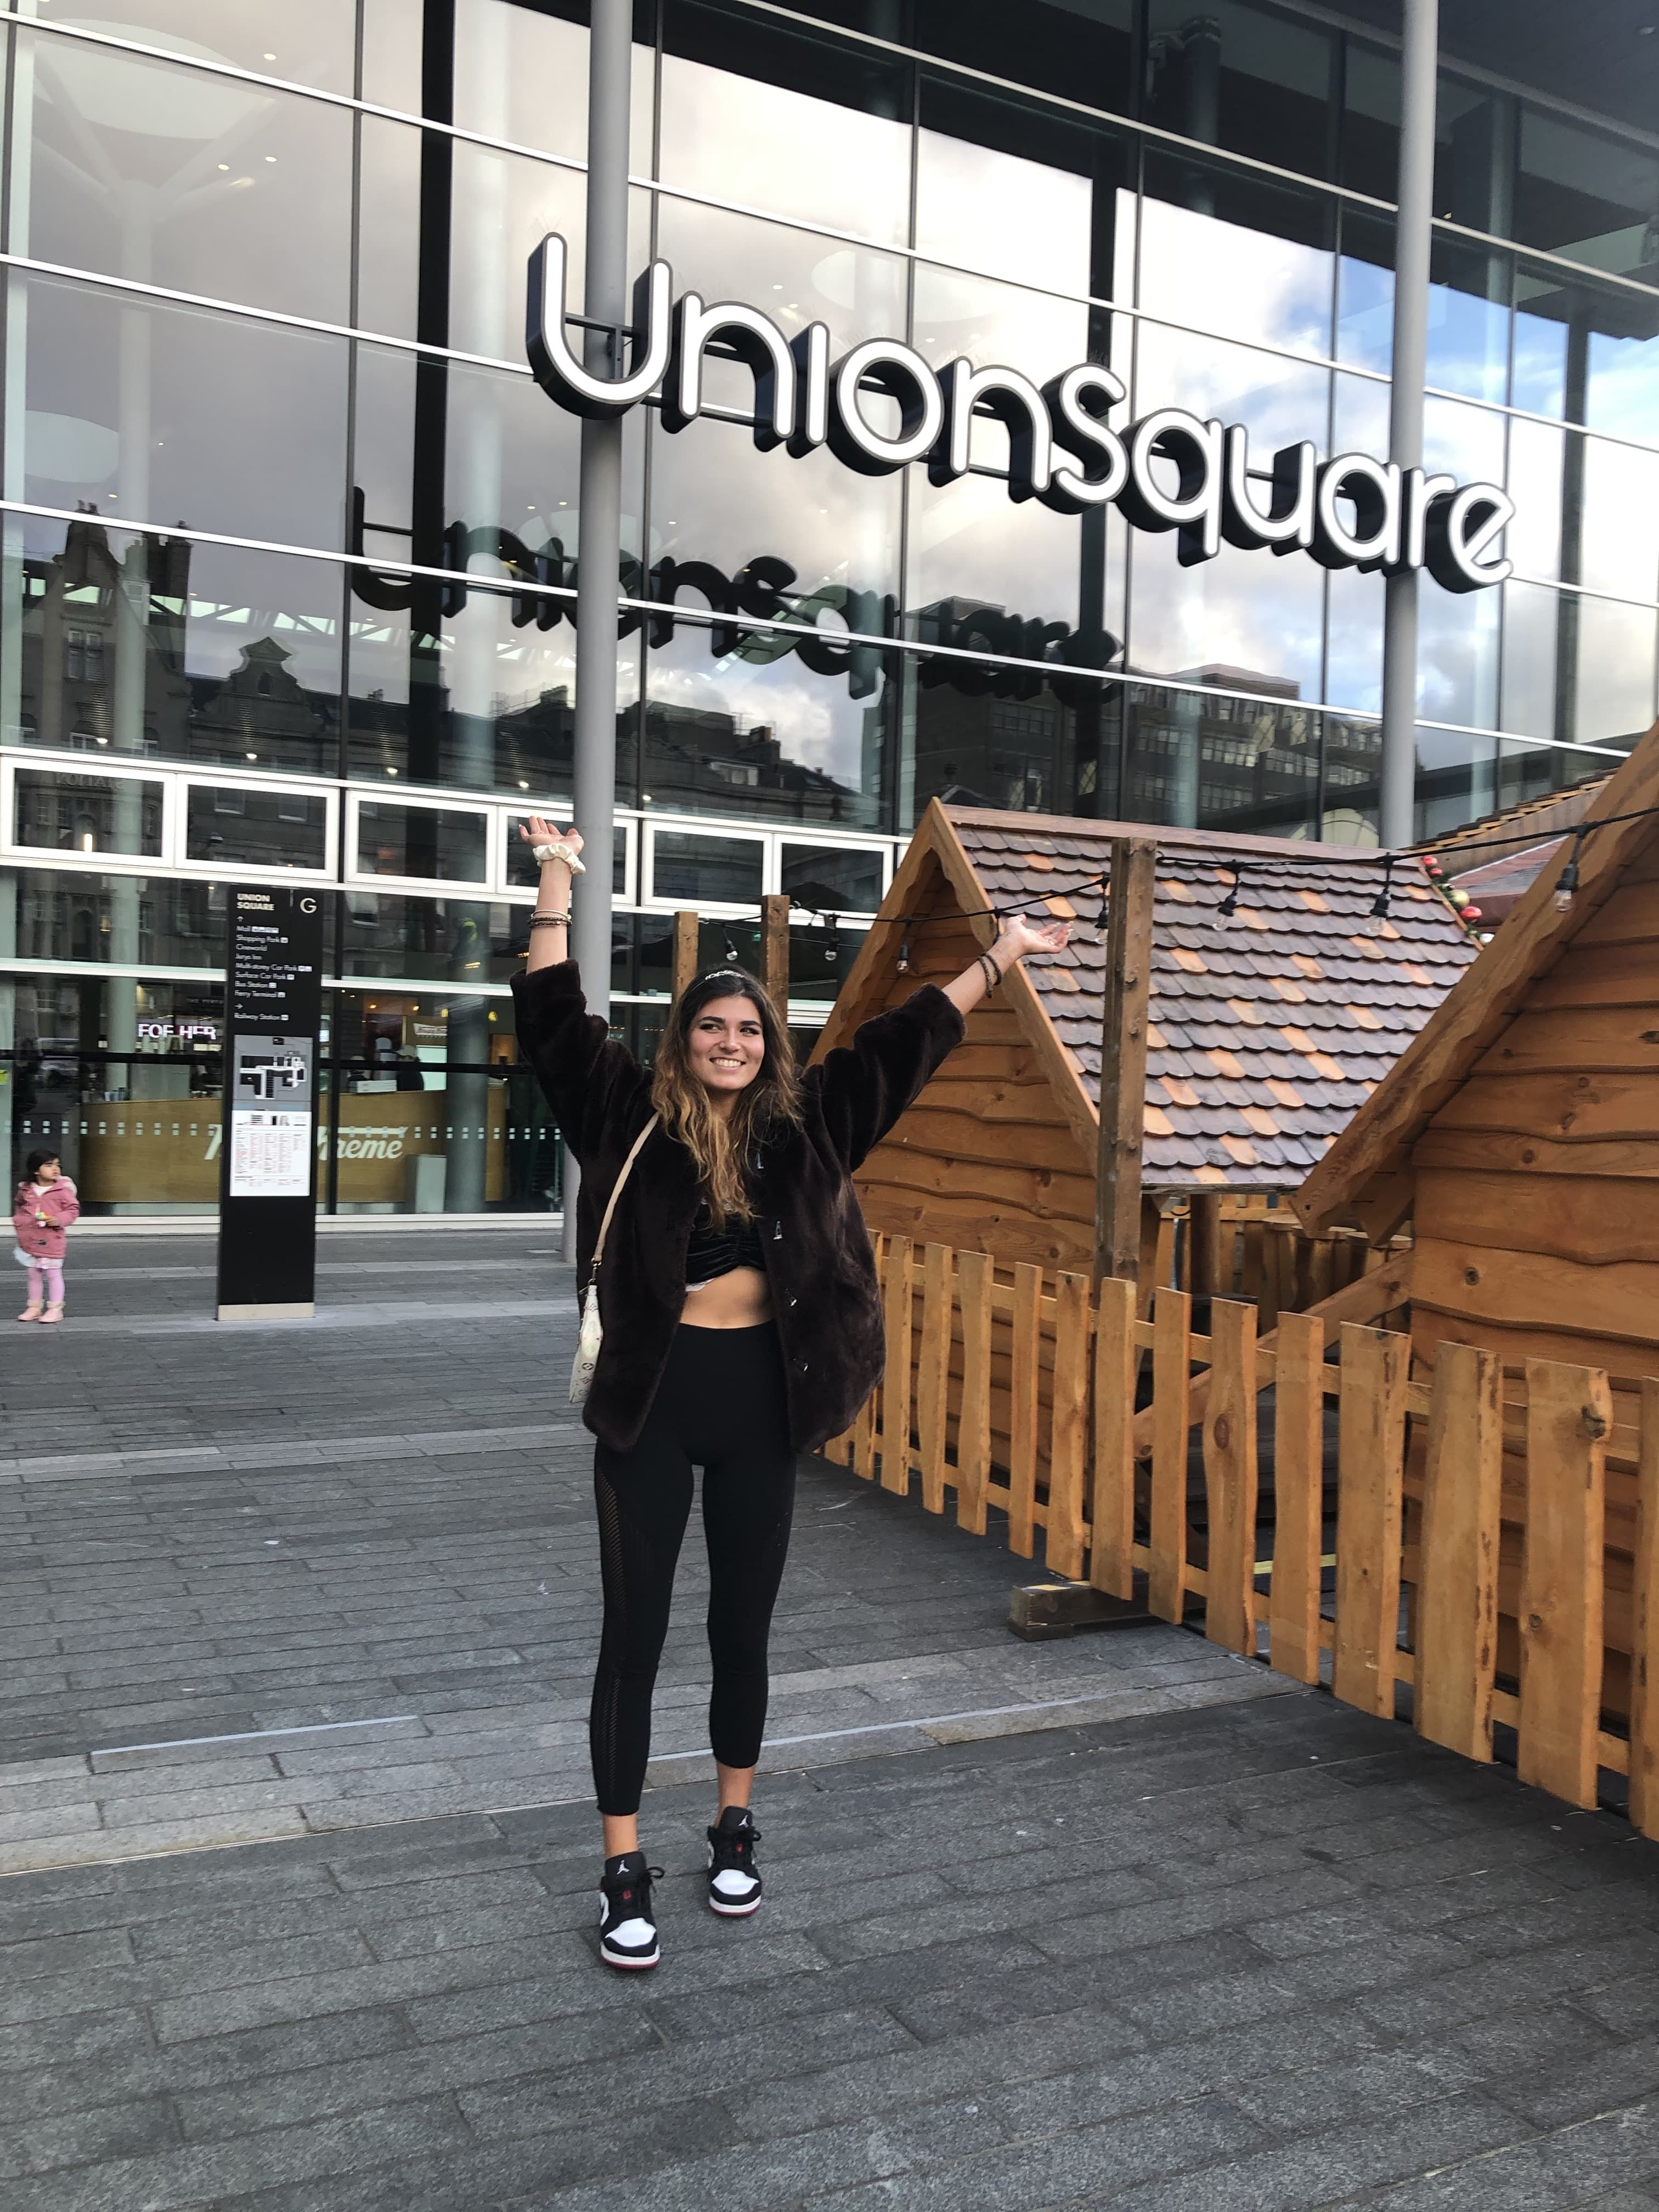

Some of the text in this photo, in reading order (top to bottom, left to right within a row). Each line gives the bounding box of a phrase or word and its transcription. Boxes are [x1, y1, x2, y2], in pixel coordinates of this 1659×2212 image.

[236, 893, 270, 902] UNION
[236, 902, 274, 911] SQUARE
[300, 898, 317, 913] G
